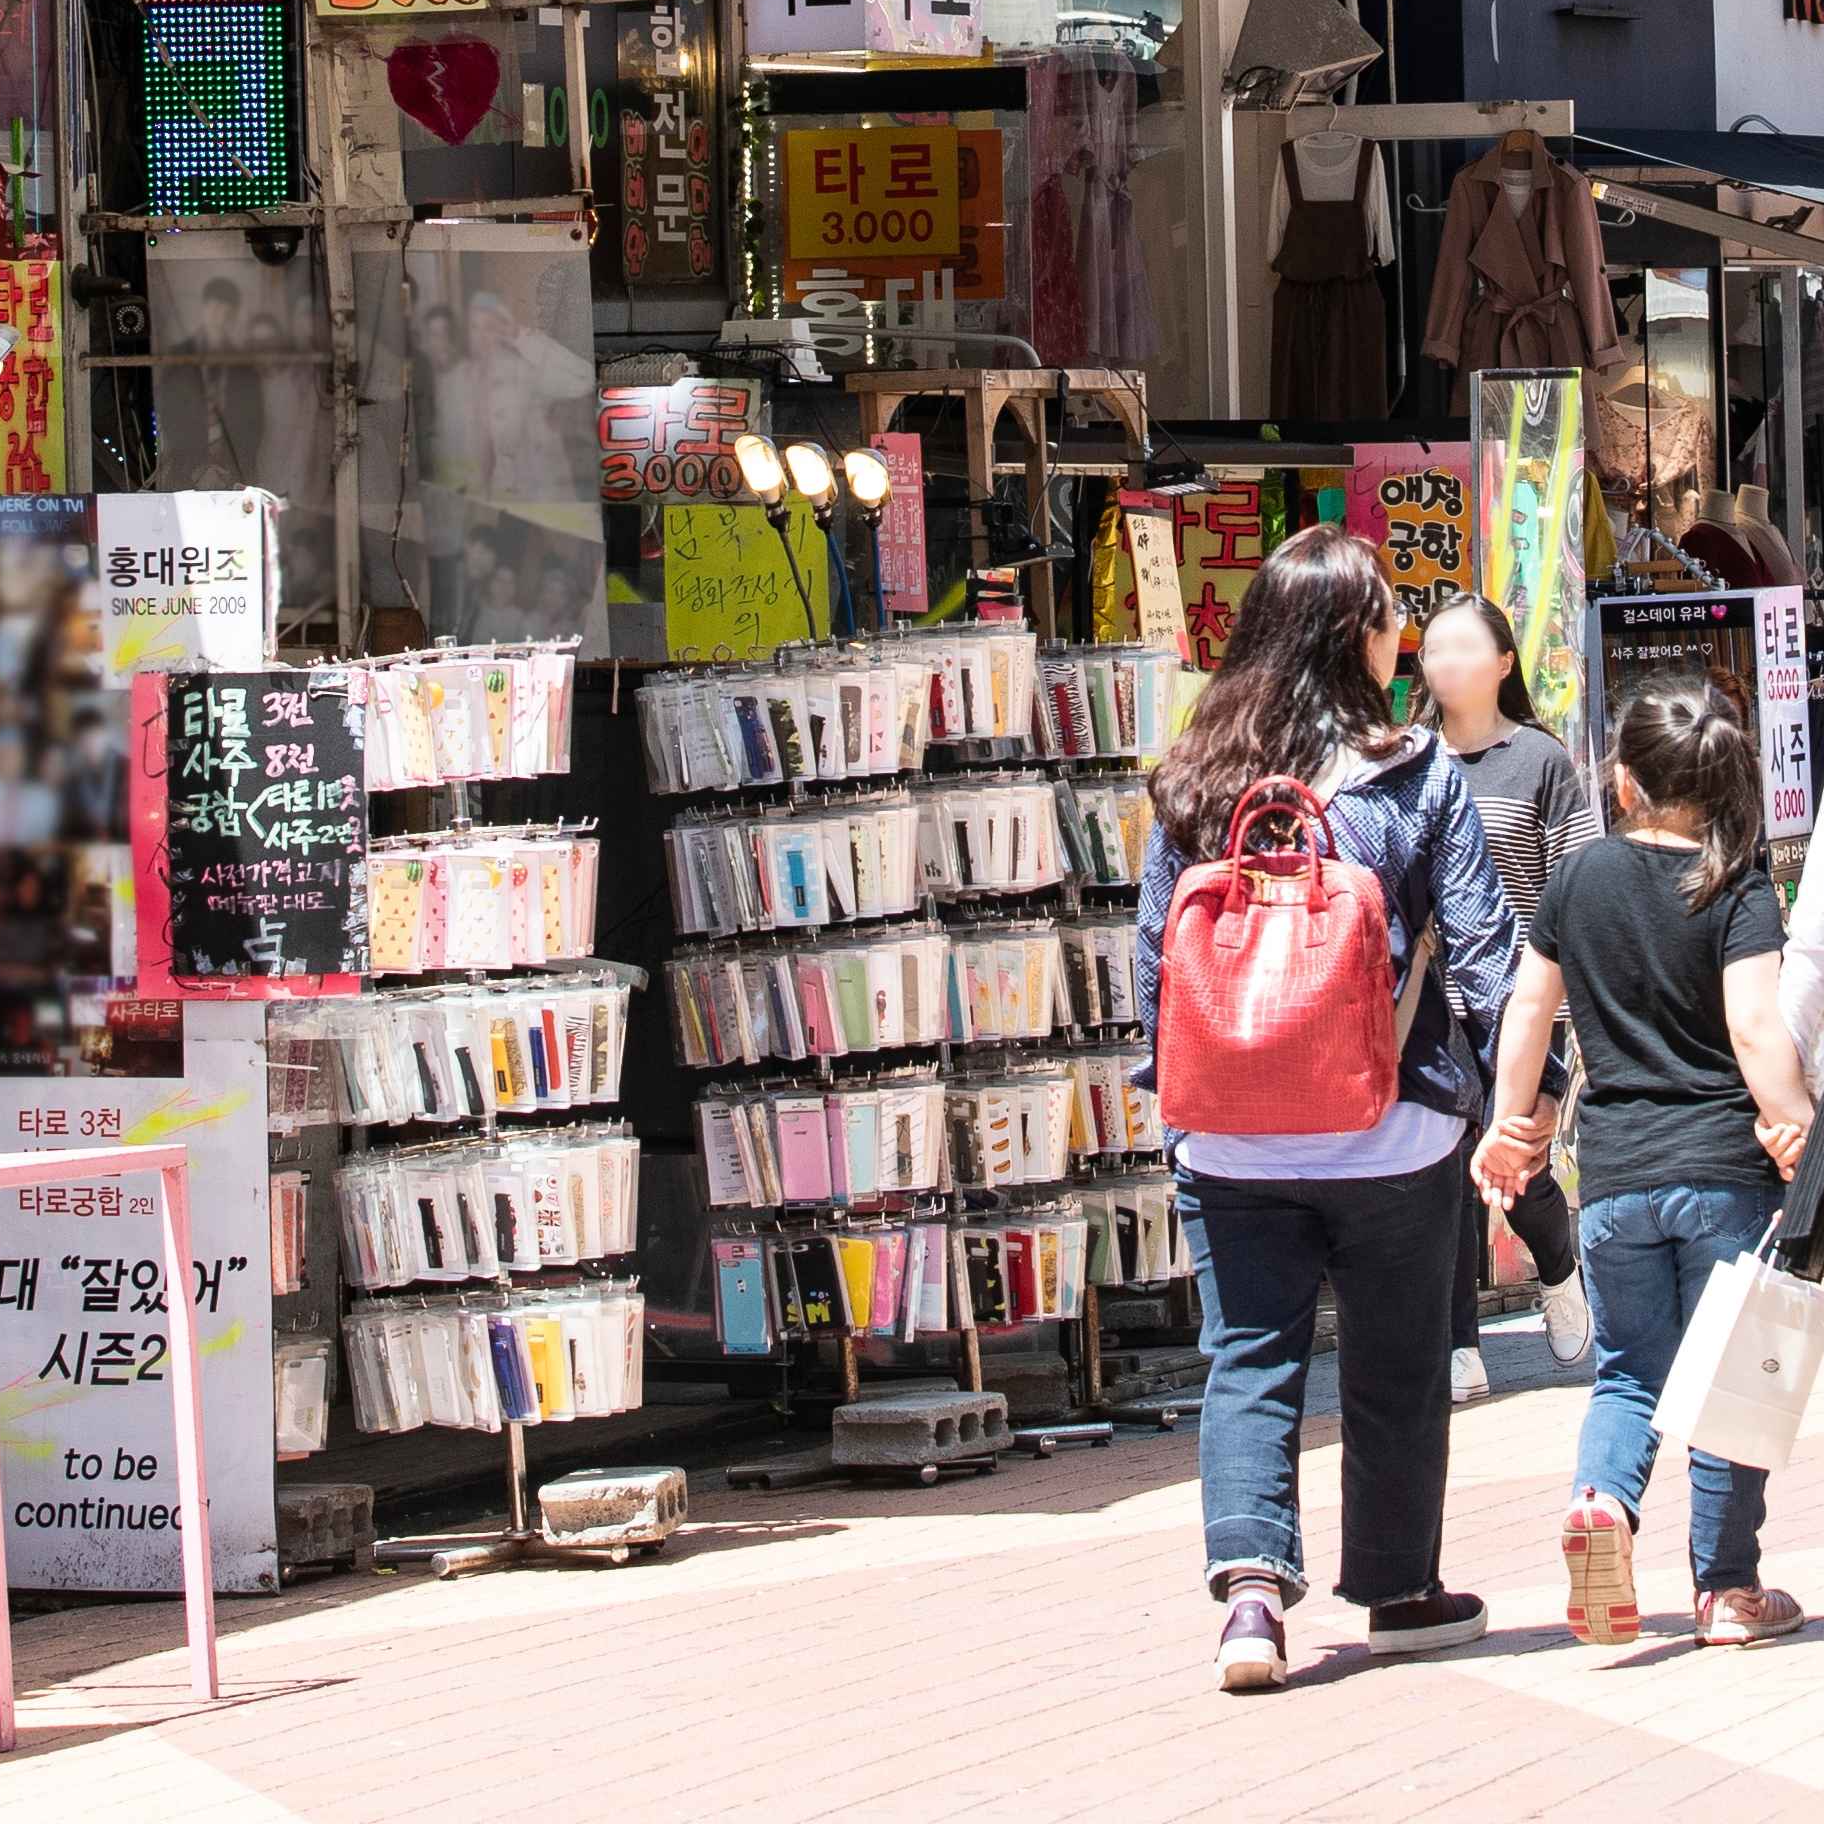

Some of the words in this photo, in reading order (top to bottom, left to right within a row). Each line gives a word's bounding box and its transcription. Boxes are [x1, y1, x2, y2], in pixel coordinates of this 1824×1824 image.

[814, 142, 939, 206] 타로
[821, 208, 934, 245] 3.000
[598, 386, 750, 454] 타로
[599, 453, 739, 503] 3000
[1379, 466, 1466, 518] 애정
[36, 498, 60, 513] ON
[106, 546, 249, 588] 홍대원조
[1387, 519, 1464, 573] 궁합
[111, 596, 157, 617] SINCE
[161, 596, 203, 616] JUNE
[209, 596, 247, 615] 2009
[1623, 606, 1676, 625] 걸스데이
[1679, 605, 1707, 621] 유라
[1610, 645, 1634, 660] 사주
[1636, 644, 1684, 658] 잘봤어요
[1763, 606, 1801, 666] 타로
[1767, 667, 1800, 702] 3.000
[183, 686, 252, 739] 타로
[262, 690, 314, 729] 3천
[182, 740, 258, 787] 사주
[264, 742, 320, 777] 8천
[1770, 722, 1807, 783] 사주
[186, 786, 248, 838] 궁합
[1775, 788, 1806, 821] 8.000
[111, 1001, 180, 1022] 사주타로
[18, 1108, 70, 1138] 타로
[79, 1107, 122, 1139] 3천
[18, 1186, 124, 1217] 타로궁합
[128, 1196, 156, 1216] 2인
[38, 1331, 169, 1386] 시즌2
[64, 1447, 102, 1481] to
[113, 1447, 158, 1481] be
